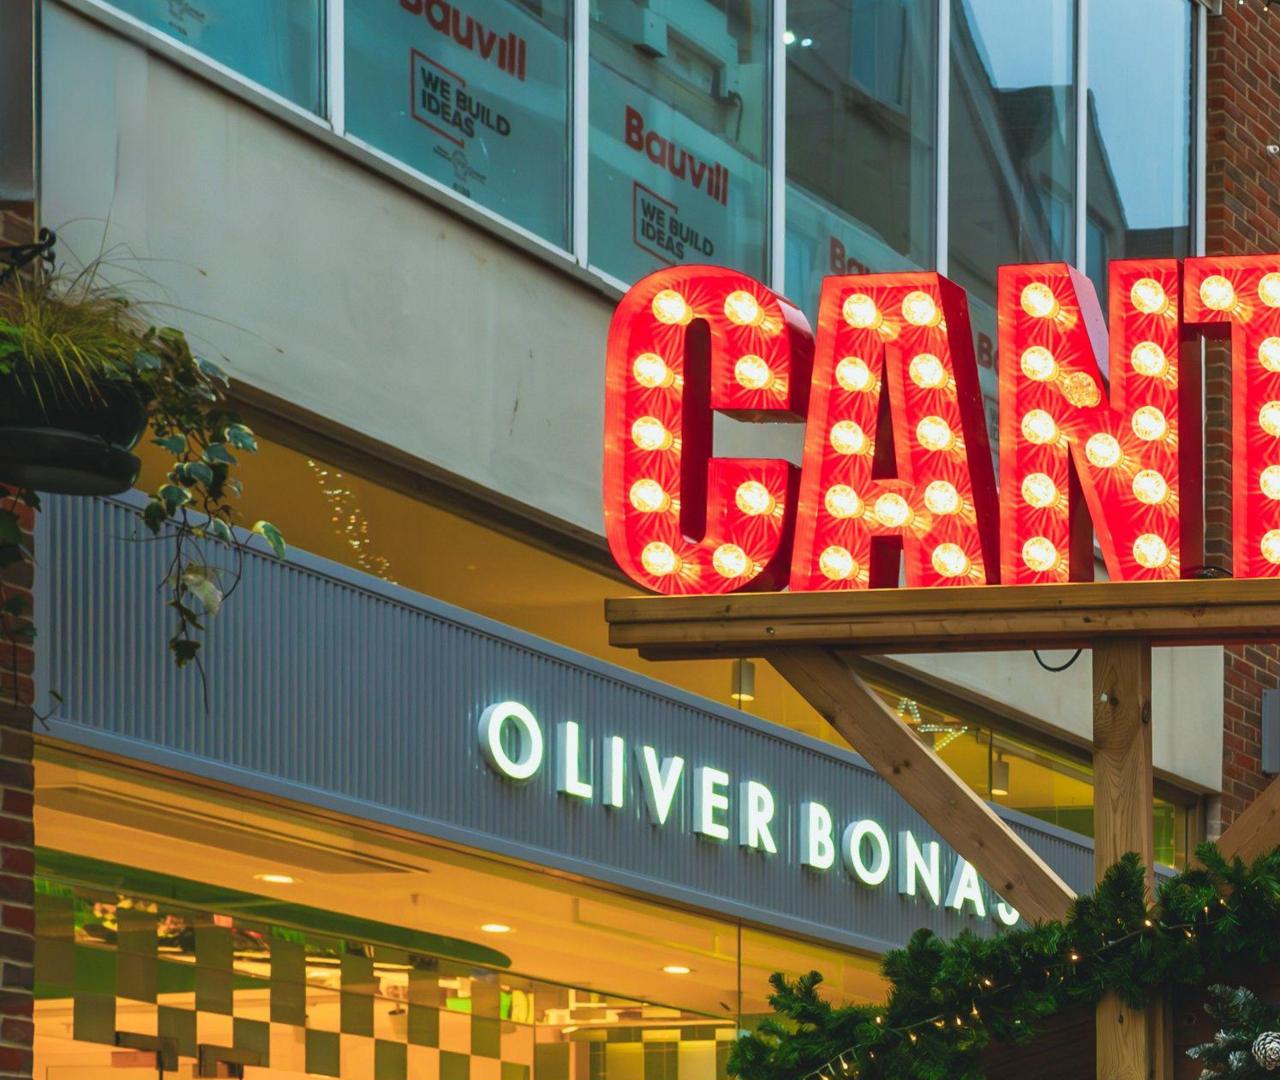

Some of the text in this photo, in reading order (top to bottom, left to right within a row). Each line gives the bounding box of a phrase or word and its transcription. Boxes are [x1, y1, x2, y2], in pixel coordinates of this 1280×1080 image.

[420, 66, 511, 137] WE BUILD
[421, 89, 475, 139] IDEAS
[625, 105, 730, 207] Bauvill
[641, 198, 714, 257] WE BUILD
[641, 218, 684, 260] IDEAS
[478, 700, 778, 854] OLIVER
